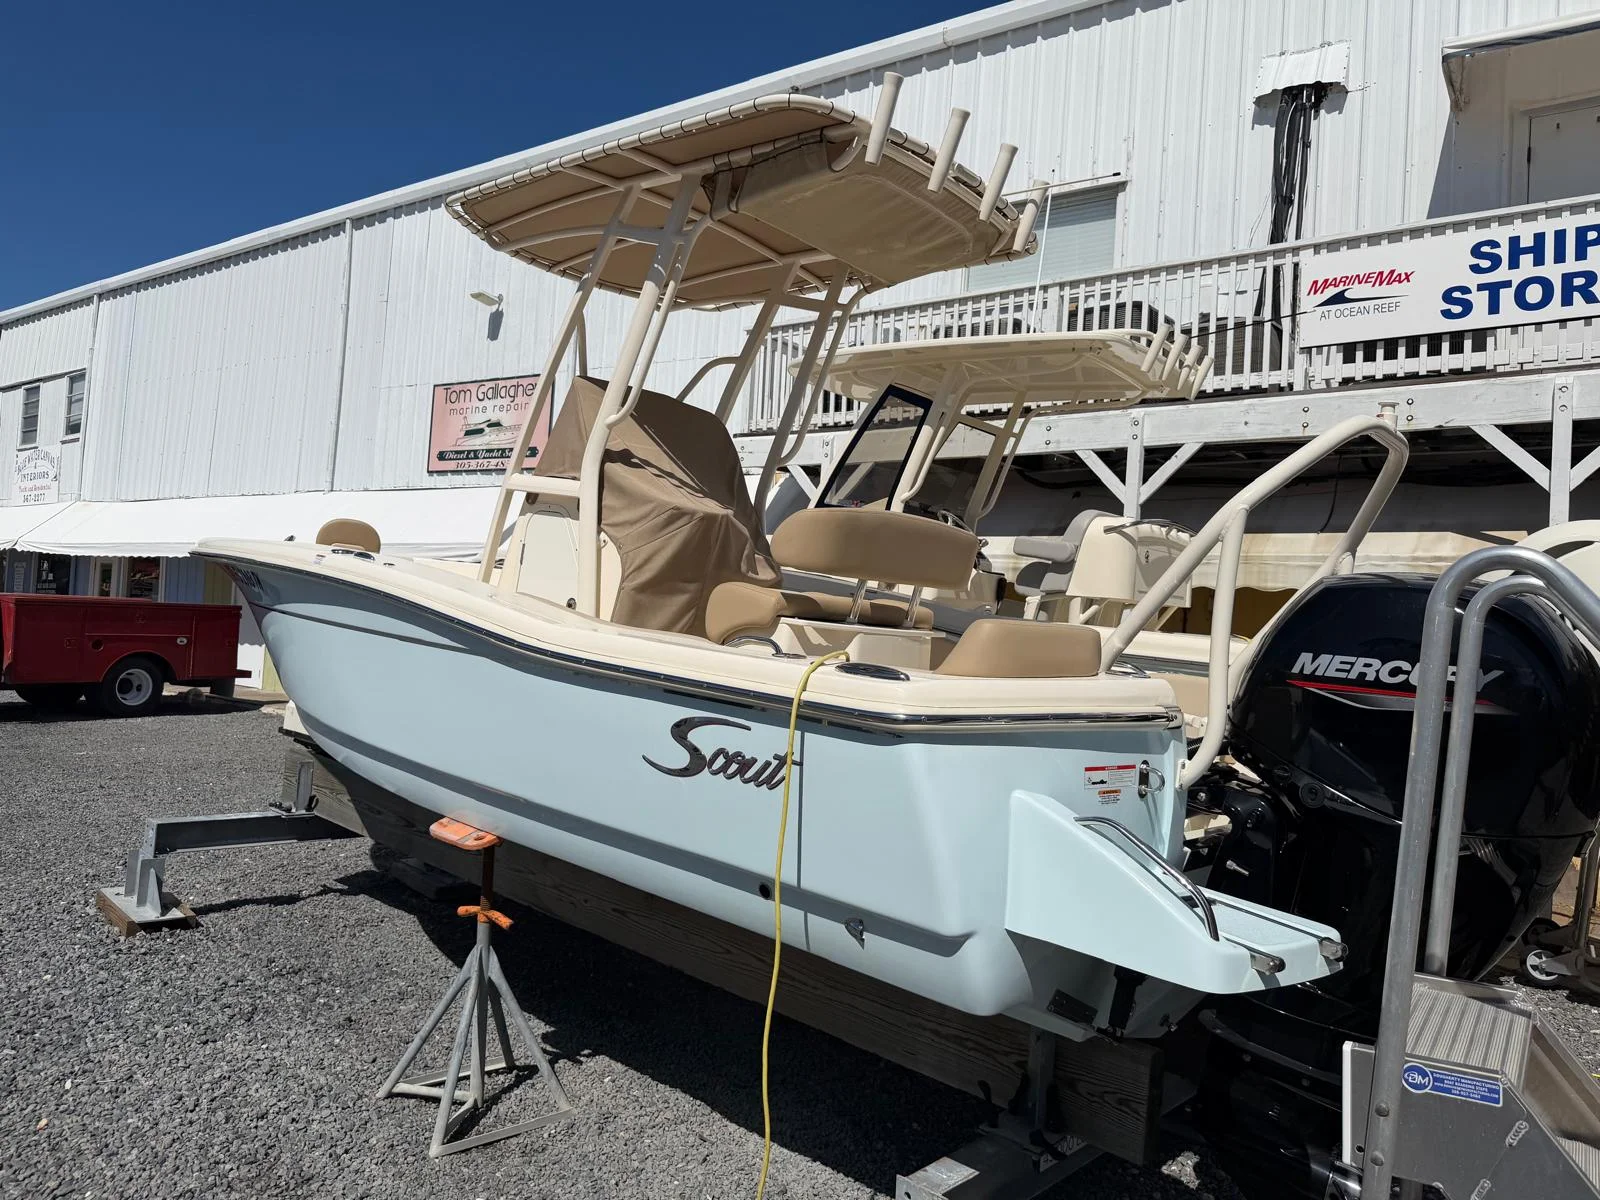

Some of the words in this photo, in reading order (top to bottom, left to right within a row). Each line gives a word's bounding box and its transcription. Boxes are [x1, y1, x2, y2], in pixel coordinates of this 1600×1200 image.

[1468, 223, 1600, 275] SHIP
[1320, 309, 1332, 321] AT
[1334, 305, 1371, 319] OCEAN
[1373, 301, 1400, 314] REEF
[443, 386, 472, 404] Tom
[450, 404, 487, 416] marine
[493, 401, 529, 414] repair
[443, 450, 468, 460] Diesel
[477, 449, 501, 459] Yacht
[20, 470, 50, 482] INTERIORS
[1291, 652, 1505, 692] MERCY
[642, 716, 802, 790] Scout
